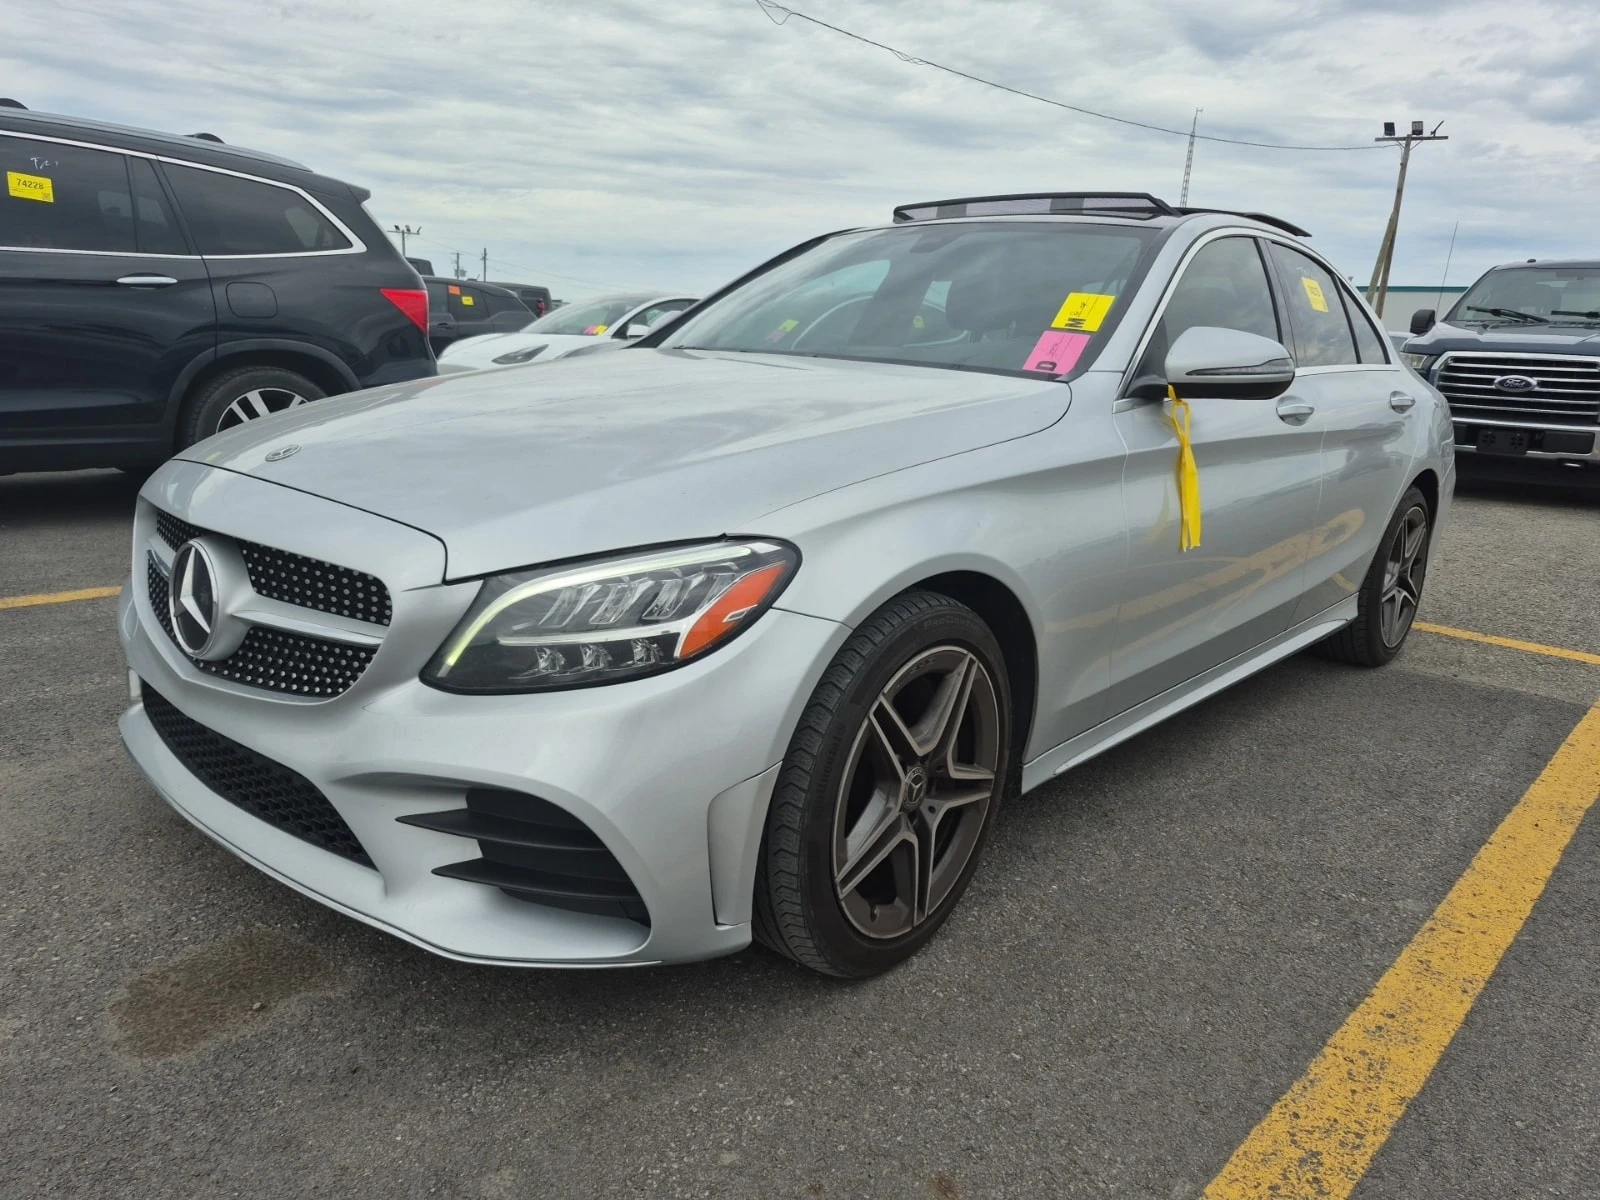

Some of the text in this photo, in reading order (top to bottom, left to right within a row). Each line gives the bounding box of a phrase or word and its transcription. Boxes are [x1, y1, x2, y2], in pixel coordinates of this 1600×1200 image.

[16, 178, 44, 190] 74228
[1035, 360, 1057, 371] D
[1503, 378, 1526, 388] Ford
